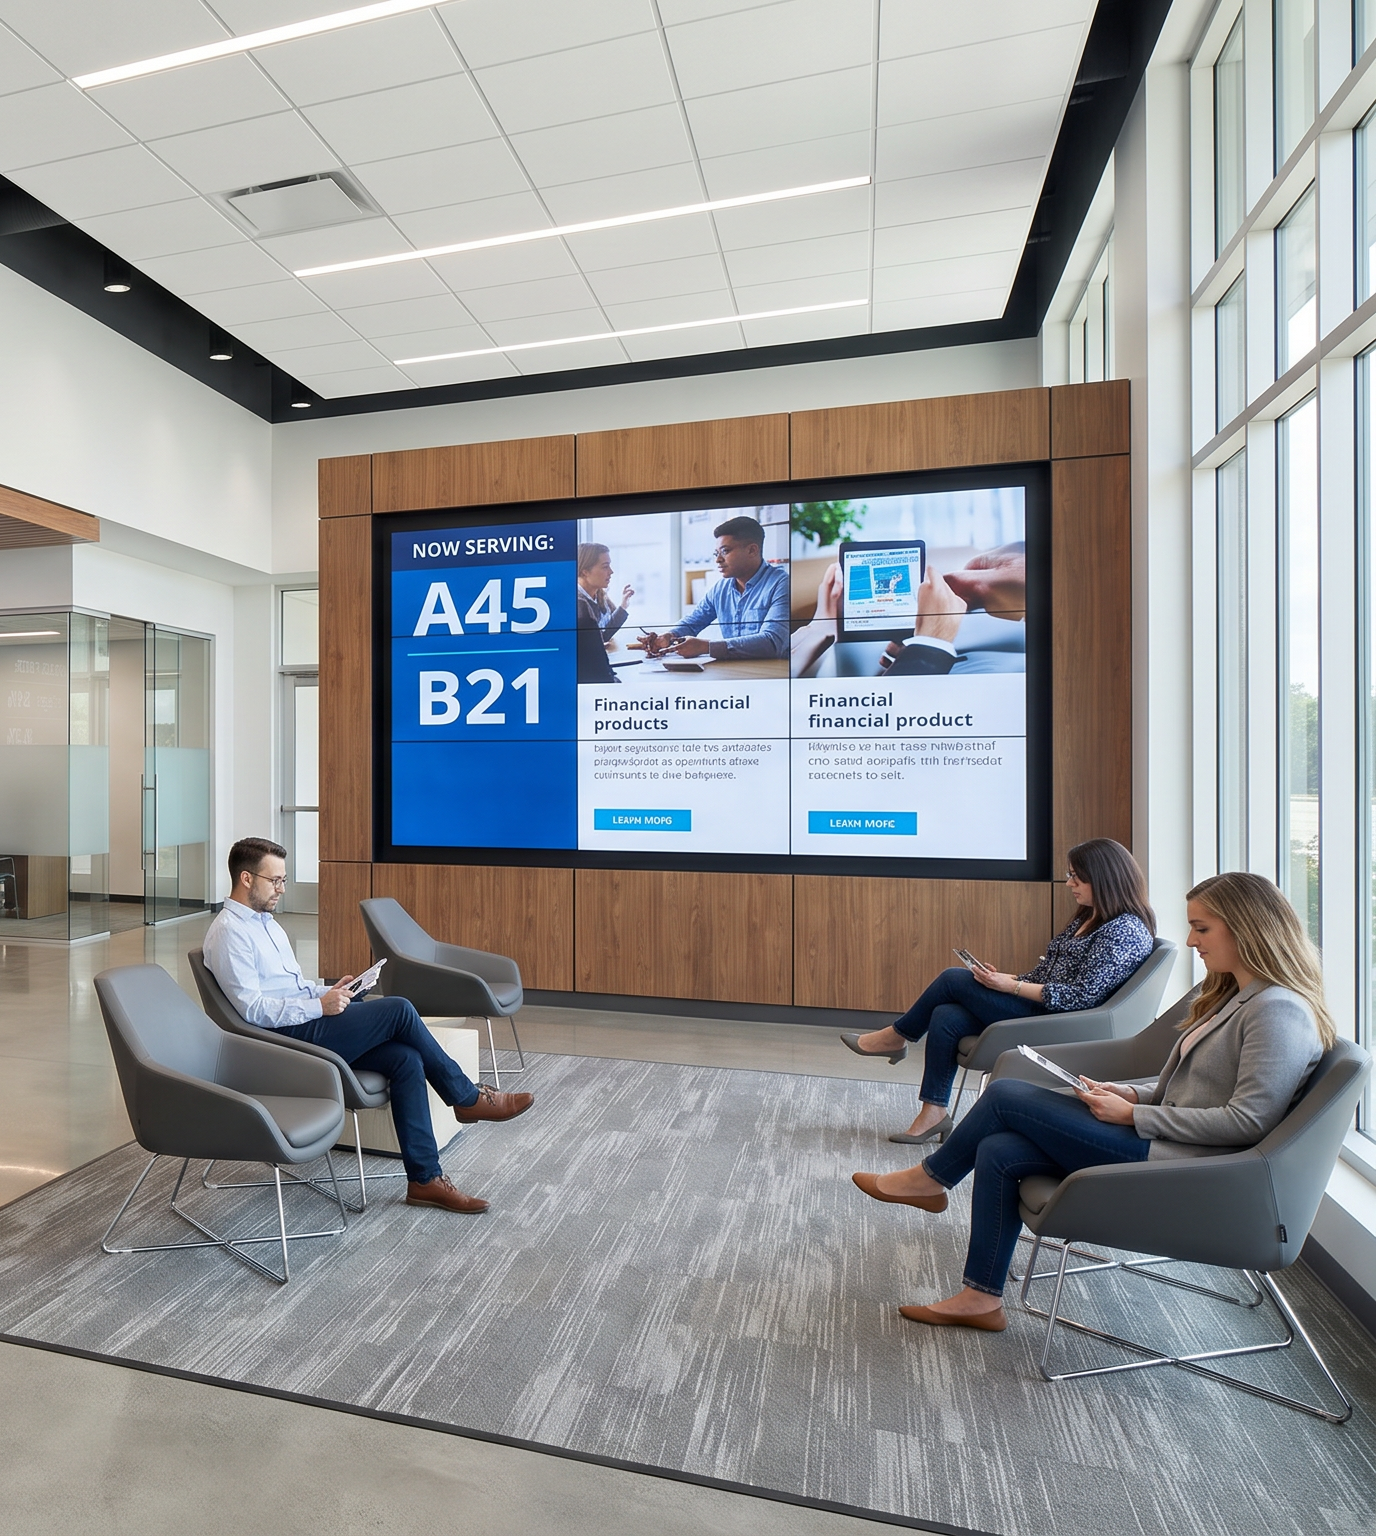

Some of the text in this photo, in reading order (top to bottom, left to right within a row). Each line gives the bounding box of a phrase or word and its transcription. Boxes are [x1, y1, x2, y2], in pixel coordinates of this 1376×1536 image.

[412, 534, 555, 559] NOW SERVING:
[412, 576, 551, 637] A45
[419, 667, 540, 726] B21
[593, 695, 751, 712] Financial financial
[808, 692, 894, 708] Financial
[593, 717, 669, 735] products
[808, 712, 974, 732] financial product
